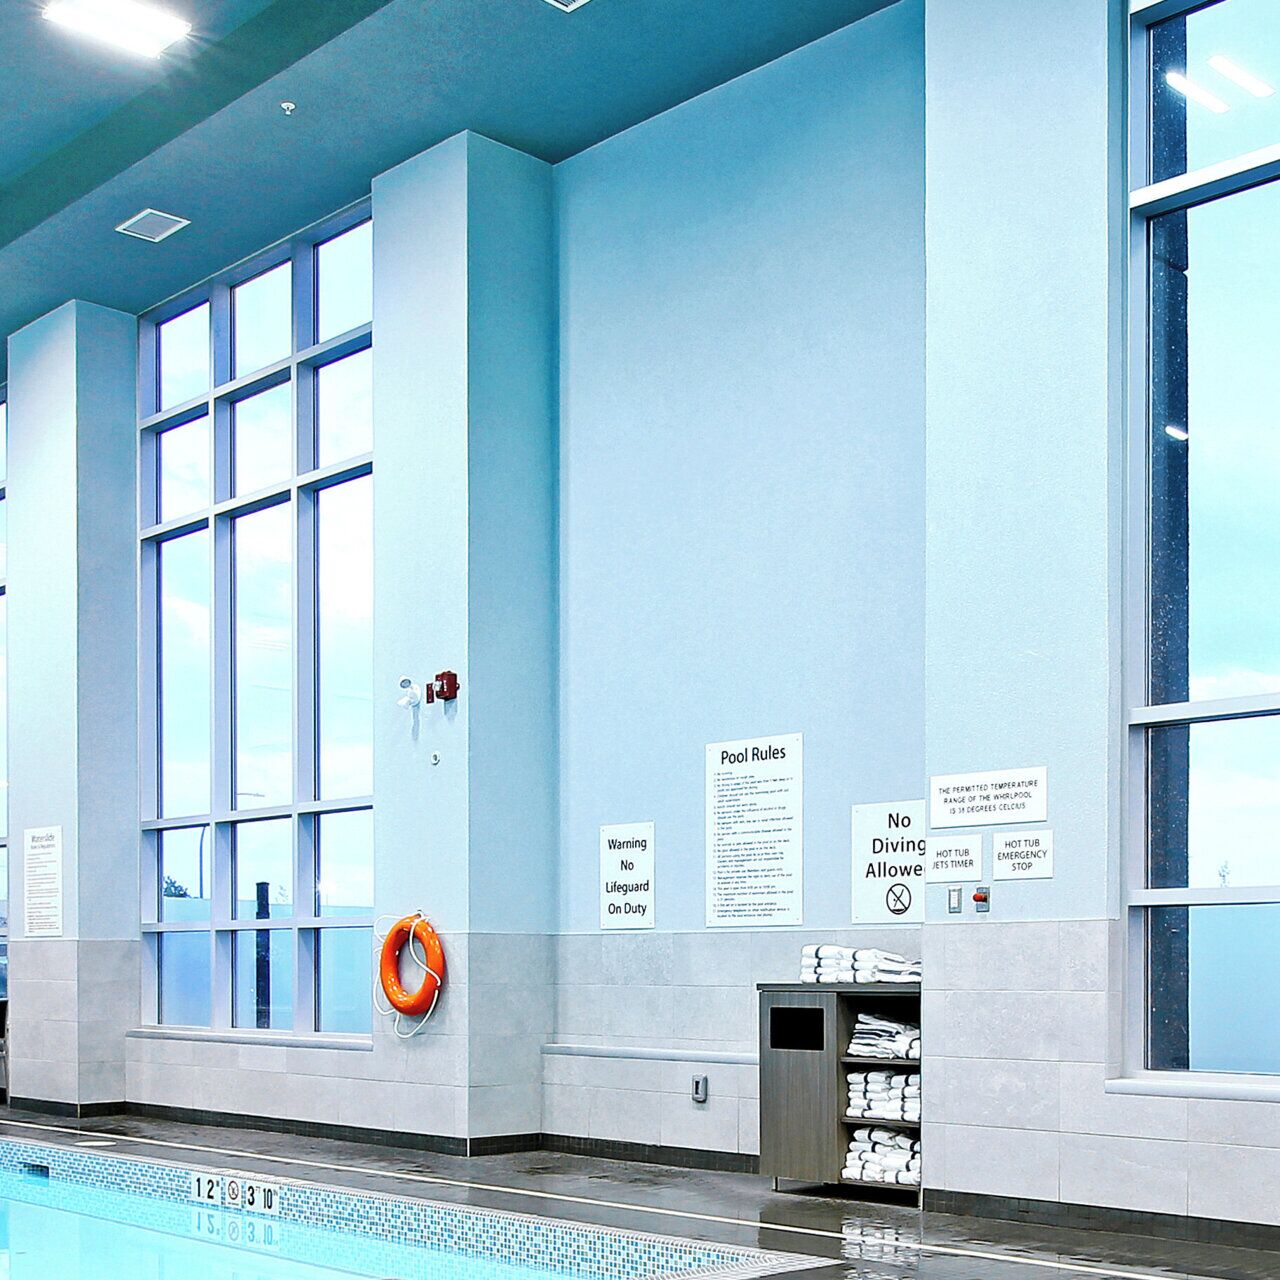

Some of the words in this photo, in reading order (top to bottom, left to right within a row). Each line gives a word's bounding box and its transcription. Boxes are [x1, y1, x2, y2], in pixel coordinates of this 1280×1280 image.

[721, 747, 748, 765] Pool
[751, 745, 786, 762] Rules
[939, 787, 950, 795] THE
[952, 783, 988, 794] PERMITTED
[991, 779, 1038, 791] TEMPERATURE
[979, 794, 990, 802] THE
[993, 791, 1032, 801] WHIRLPOOL
[950, 807, 956, 815] IS
[967, 804, 996, 813] DEGREES
[888, 812, 911, 829] No
[608, 837, 647, 851] Warning
[872, 836, 926, 856] Diving
[1005, 840, 1022, 849] HOT
[1024, 838, 1040, 848] TUB
[936, 849, 952, 858] HOT
[954, 848, 970, 857] TUB
[997, 850, 1048, 861] EMERGENCY
[620, 859, 634, 871] No
[865, 861, 926, 878] Allowe
[932, 861, 949, 870] JETS
[950, 859, 974, 868] TIMER
[1011, 862, 1033, 871] STOP
[605, 880, 650, 896] Lifeguard
[608, 903, 622, 915] On
[624, 902, 647, 917] Duty
[247, 1185, 256, 1206] 3
[263, 1188, 273, 1209] 10
